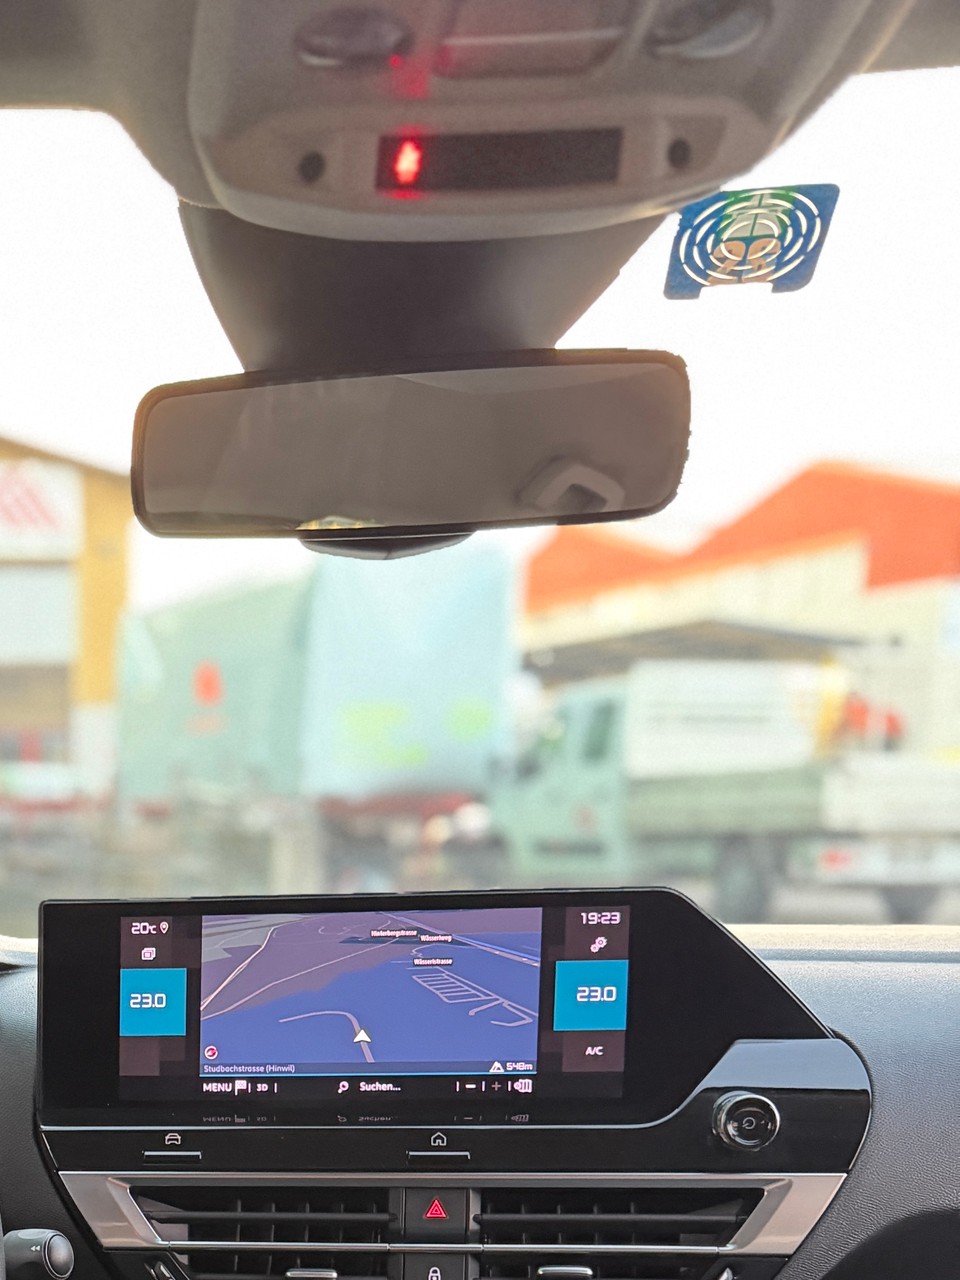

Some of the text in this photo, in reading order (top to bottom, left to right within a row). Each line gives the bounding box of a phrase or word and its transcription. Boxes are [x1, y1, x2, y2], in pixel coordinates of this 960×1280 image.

[581, 912, 621, 925] 19:23
[577, 986, 617, 1001] 23.0
[130, 994, 166, 1008] 23.0
[585, 1046, 604, 1056] A/C
[204, 1064, 295, 1074] Studbachstrasse (Hinwil)
[506, 1062, 533, 1071] 548m
[203, 1083, 232, 1092] MENU
[256, 1083, 269, 1092] 3D
[359, 1082, 401, 1092] Suchen...
